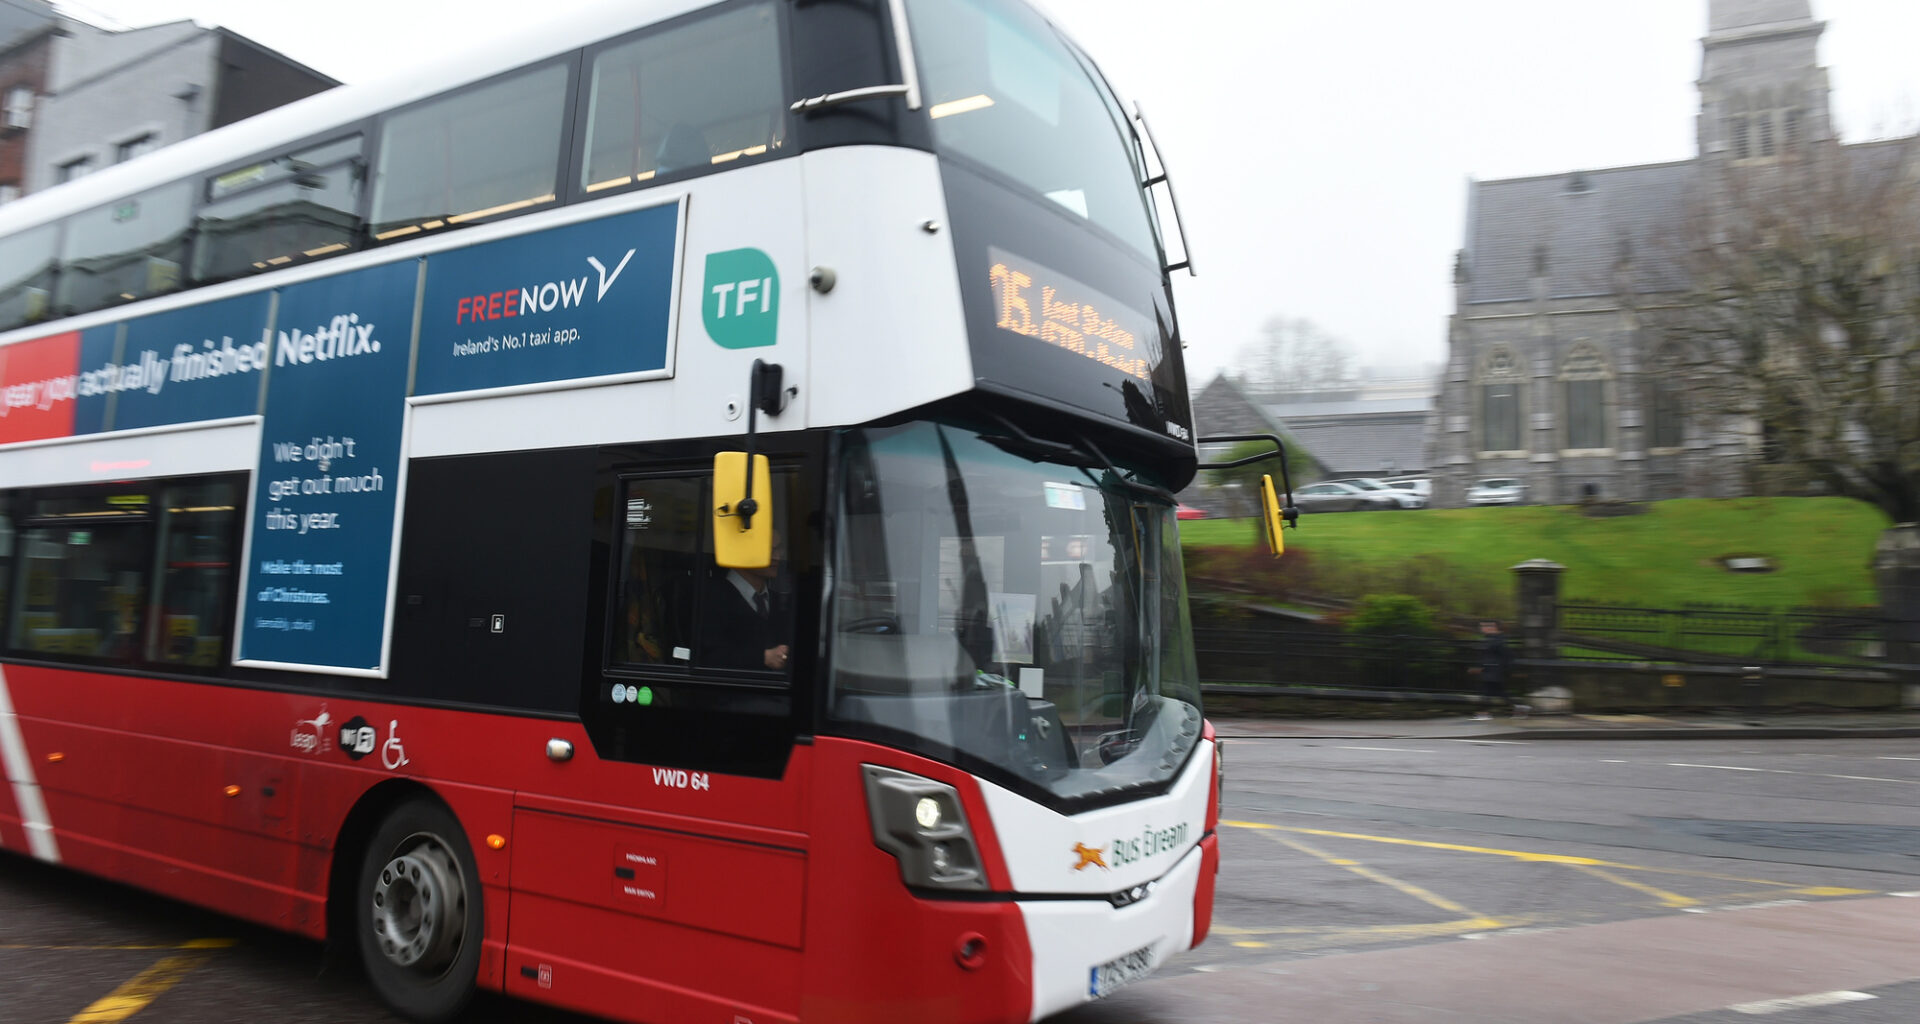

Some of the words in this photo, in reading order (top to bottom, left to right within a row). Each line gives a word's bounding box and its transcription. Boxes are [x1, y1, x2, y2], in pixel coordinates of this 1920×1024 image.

[712, 277, 772, 319] TFI
[78, 350, 169, 395] actually
[170, 328, 271, 382] finished
[275, 312, 381, 367] Netflix.
[452, 335, 499, 357] Ireland's
[502, 332, 526, 350] No.1
[529, 327, 551, 346] taxi
[553, 328, 581, 346] app.
[273, 441, 303, 463] We
[304, 436, 356, 460] didn't
[269, 476, 300, 501] get
[302, 475, 332, 494] out
[334, 467, 383, 493] much
[266, 507, 298, 530] this
[652, 767, 688, 788] VWD
[690, 771, 710, 791] 64
